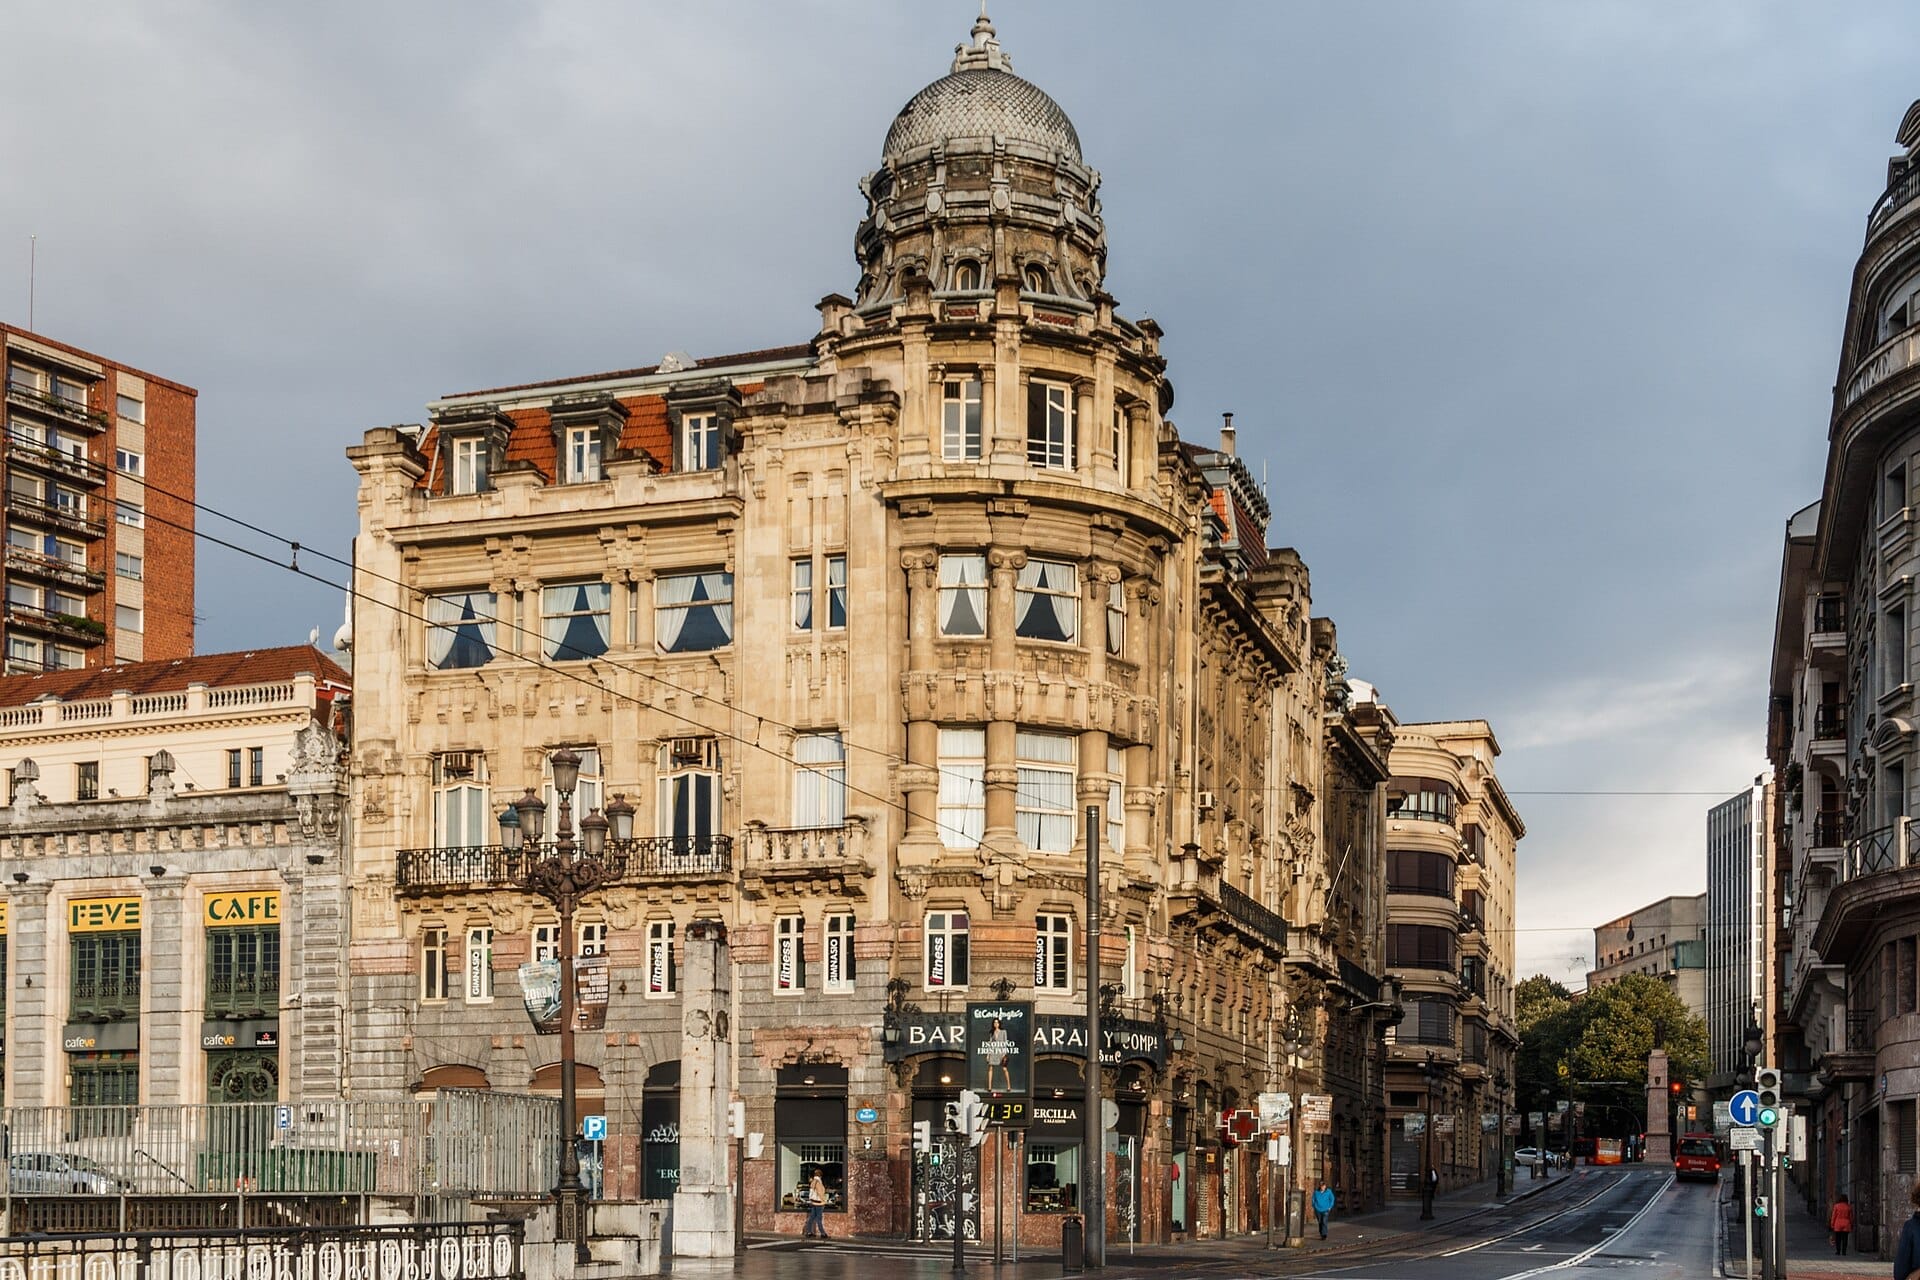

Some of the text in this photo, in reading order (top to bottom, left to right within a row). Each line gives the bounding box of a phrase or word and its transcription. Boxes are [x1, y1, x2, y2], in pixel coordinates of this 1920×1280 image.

[72, 902, 140, 926] FEVE
[208, 896, 278, 920] CAFE
[1035, 937, 1045, 985] GIMNASIO
[472, 951, 480, 996] GIMNASIO
[65, 1036, 96, 1048] cafeve
[203, 1034, 235, 1046] cafeve
[1103, 1030, 1114, 1048] Y
[1033, 1108, 1077, 1120] ERCILLA
[588, 1118, 602, 1138] P
